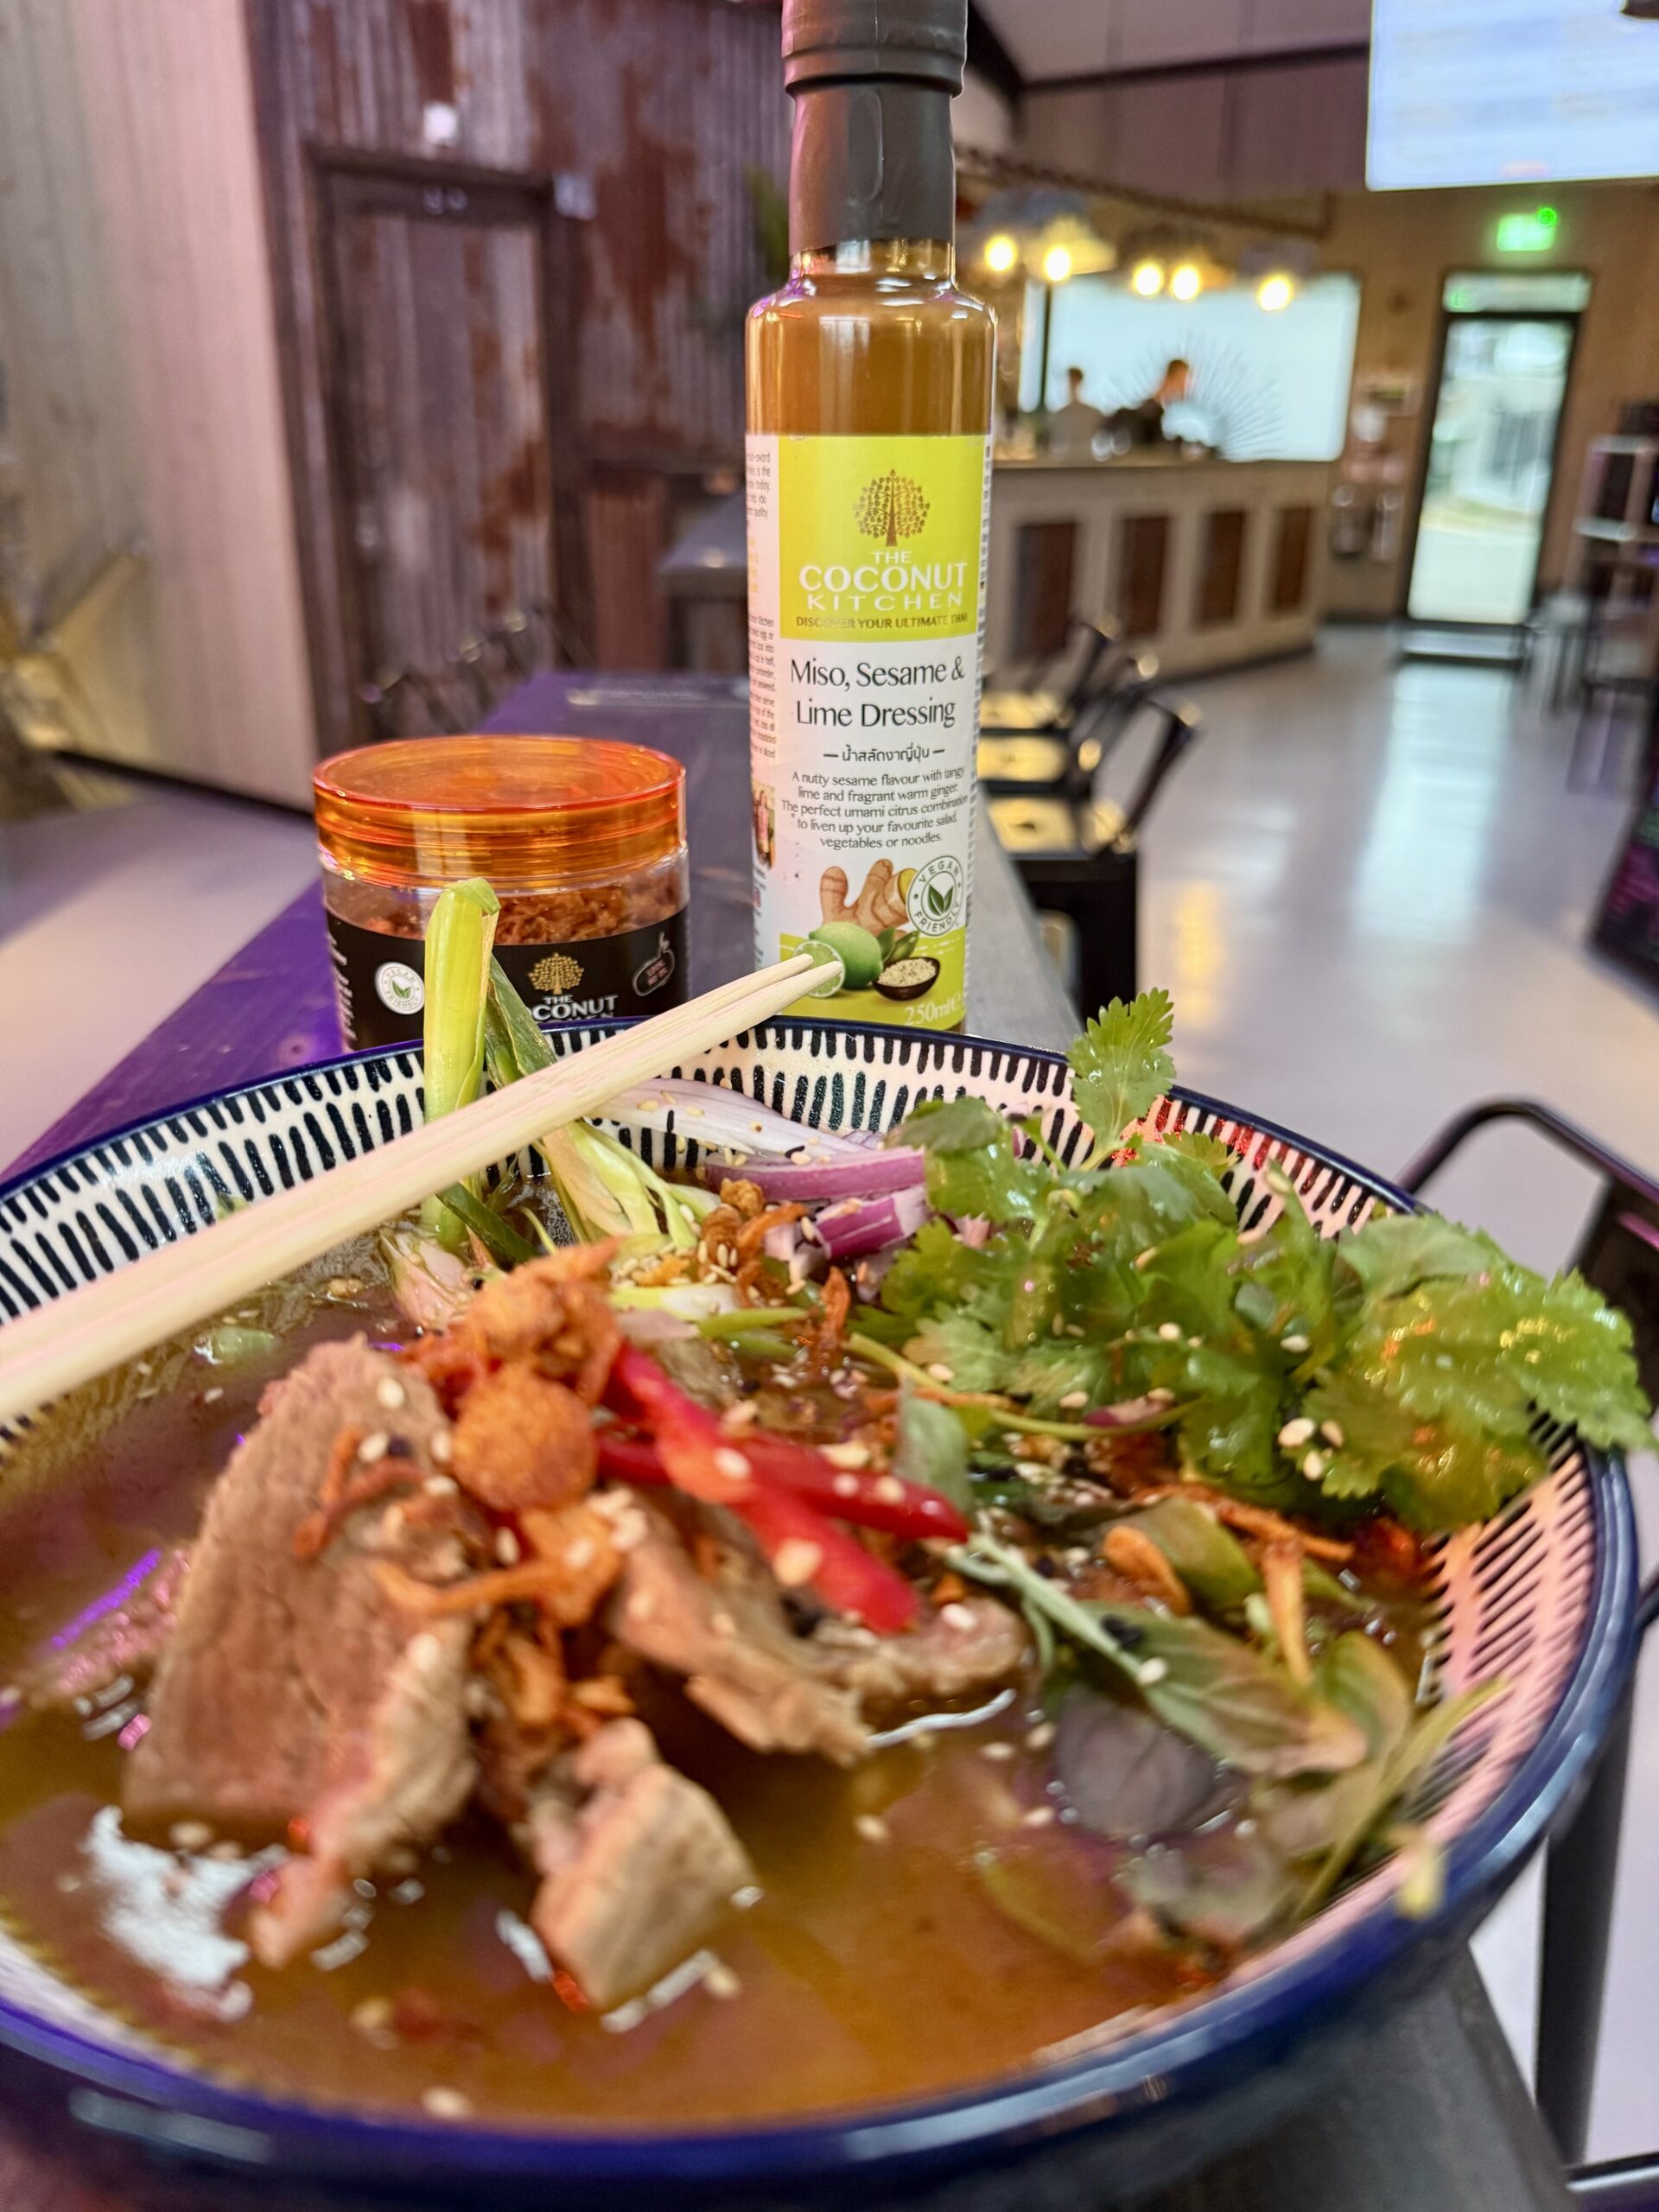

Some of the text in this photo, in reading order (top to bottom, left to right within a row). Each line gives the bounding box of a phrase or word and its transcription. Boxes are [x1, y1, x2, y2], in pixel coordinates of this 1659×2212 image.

[872, 550, 912, 564] THE
[799, 563, 968, 592] COCONUT
[807, 592, 963, 612] KITCHEN
[796, 613, 968, 629] DISCOVER YOUR ULTIMATE THAI
[790, 658, 851, 692] Miso,
[856, 662, 946, 688] Sesame
[951, 656, 966, 681] &
[796, 696, 957, 728] Lime Dressing
[791, 766, 965, 787] A nutty sesame flavour with tangy
[781, 794, 969, 817] The perfect umami citrus combination
[798, 786, 821, 800] lime
[823, 790, 844, 801] and
[848, 790, 895, 804] fragrant
[898, 789, 928, 800] warm
[798, 820, 808, 830] to
[810, 818, 836, 832] liven
[839, 823, 854, 836] up
[856, 823, 884, 836] your
[887, 819, 934, 833] favourite
[820, 832, 942, 851] vegetables or noodles.
[918, 860, 959, 883] VEGAN
[914, 901, 960, 932] FRIENDLY
[528, 995, 619, 1021] CONUT
[543, 995, 574, 1005] THE
